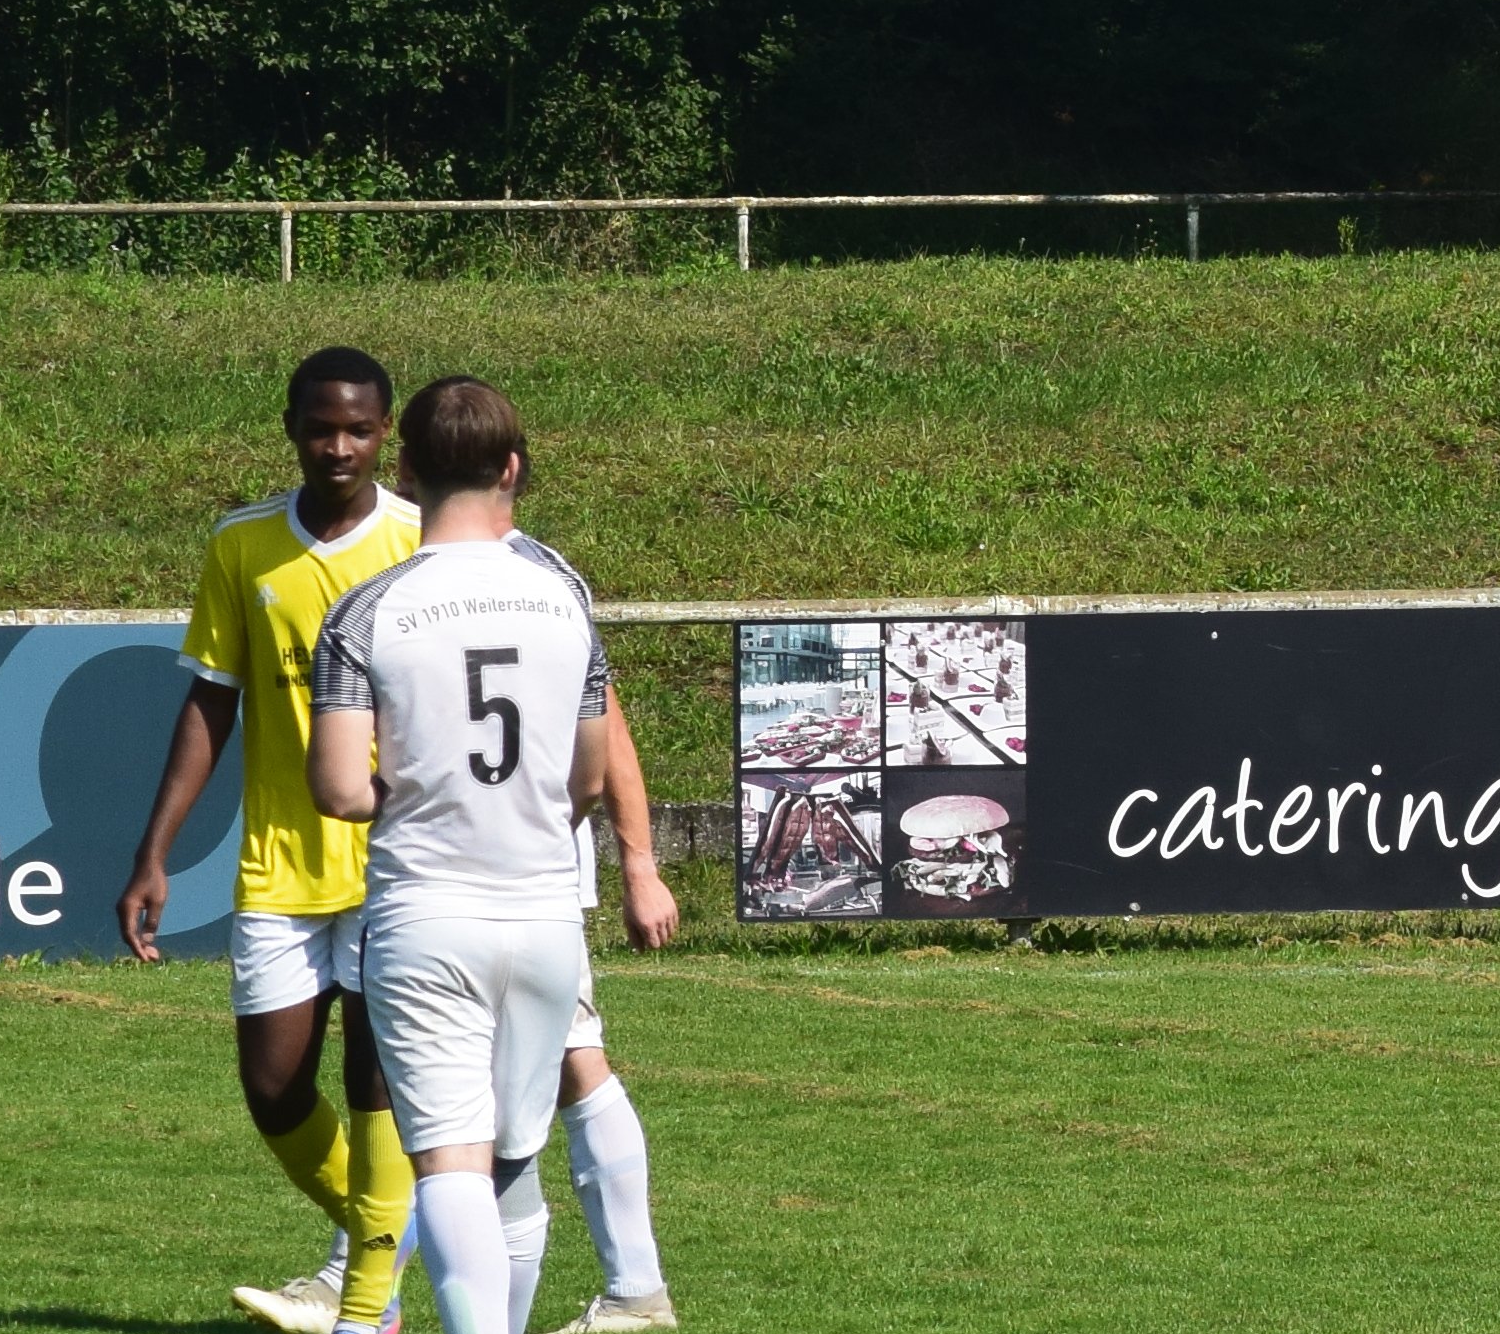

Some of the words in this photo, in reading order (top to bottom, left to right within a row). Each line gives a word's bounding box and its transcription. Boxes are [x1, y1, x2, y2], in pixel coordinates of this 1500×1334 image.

[397, 613, 418, 634] SV
[422, 601, 460, 624] 1910
[463, 597, 551, 614] Weiterstadt
[462, 646, 523, 788] 5
